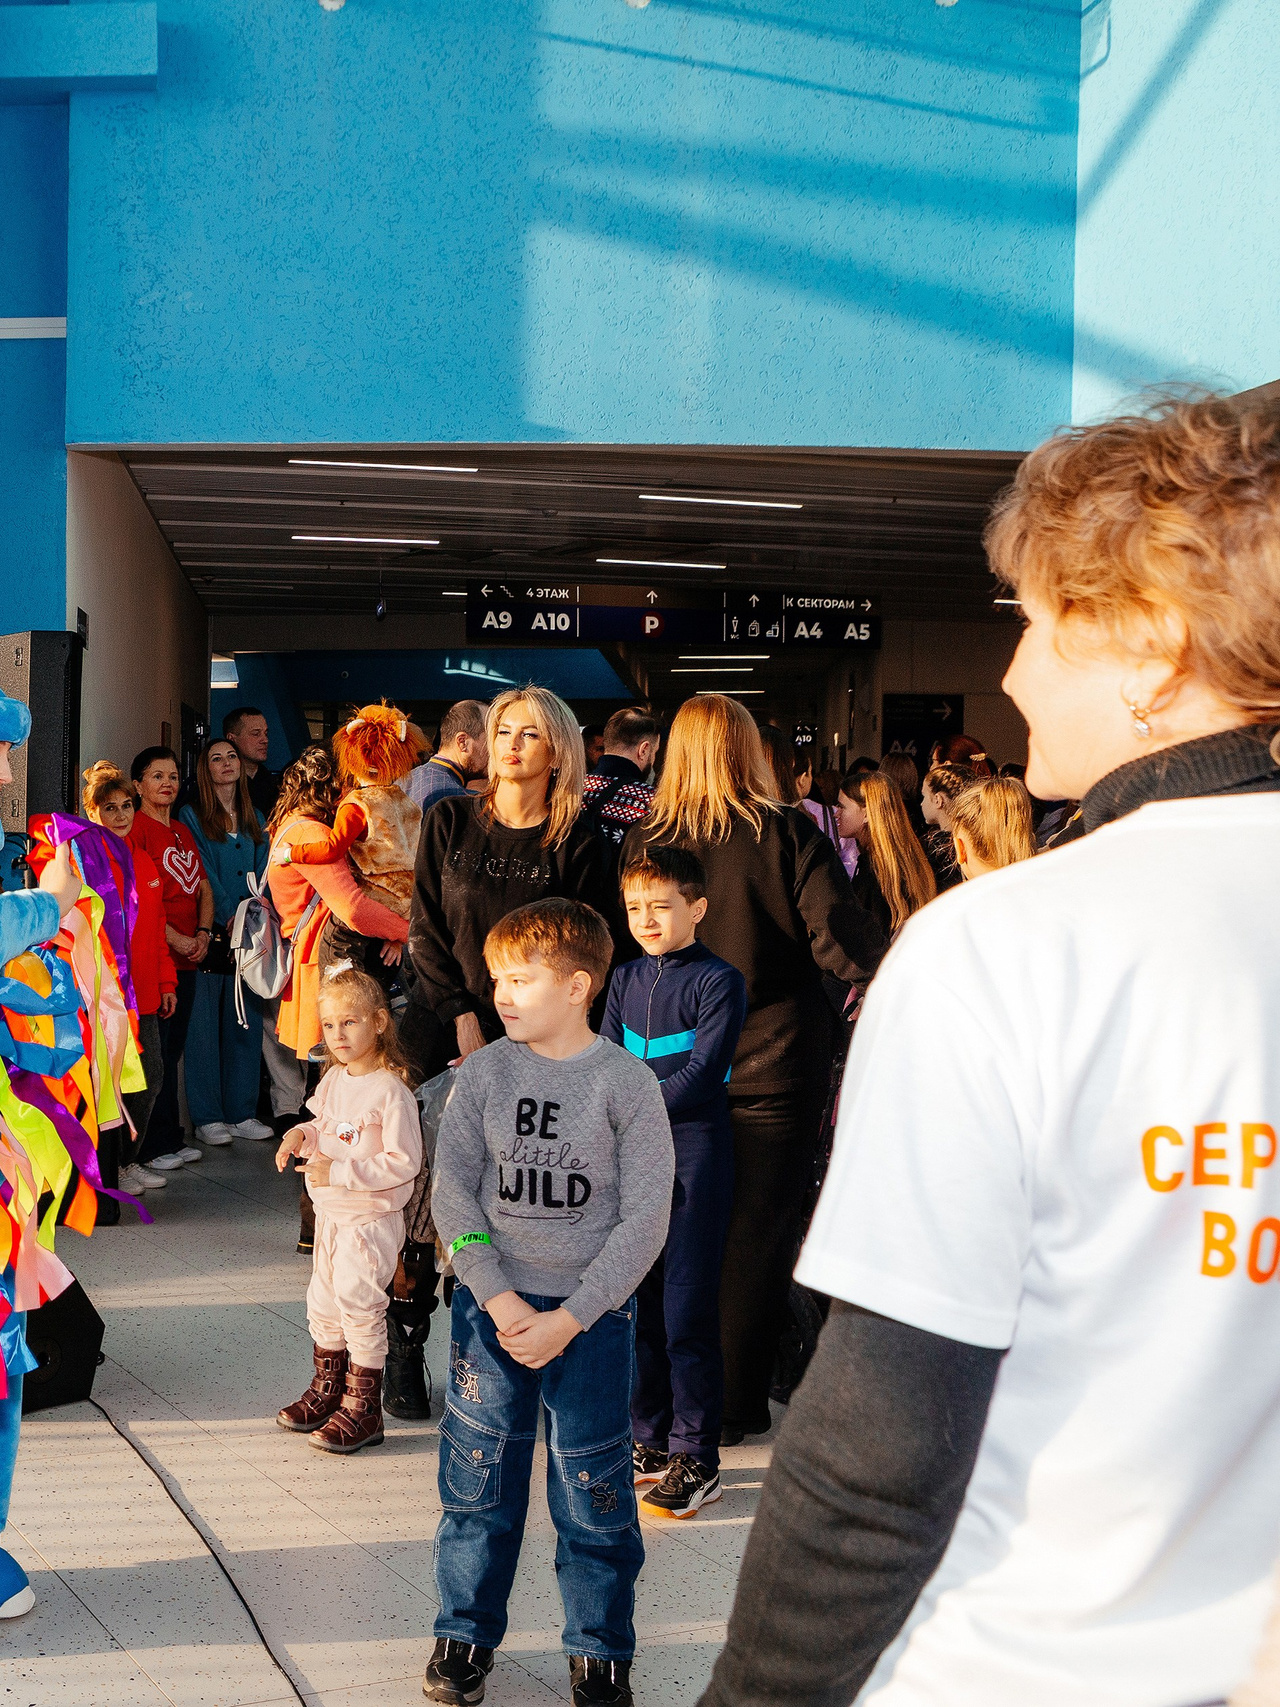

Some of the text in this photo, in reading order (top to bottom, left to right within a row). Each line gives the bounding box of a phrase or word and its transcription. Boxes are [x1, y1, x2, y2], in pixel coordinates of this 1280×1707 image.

[526, 587, 570, 599] 4 ЭТАЖ
[786, 598, 855, 609] К СЕКТОРАМ
[481, 611, 570, 631] A9 A10
[793, 621, 871, 641] A4 A5
[515, 1097, 561, 1140] BE
[1141, 1122, 1278, 1193] СЕР
[498, 1163, 592, 1209] WILD
